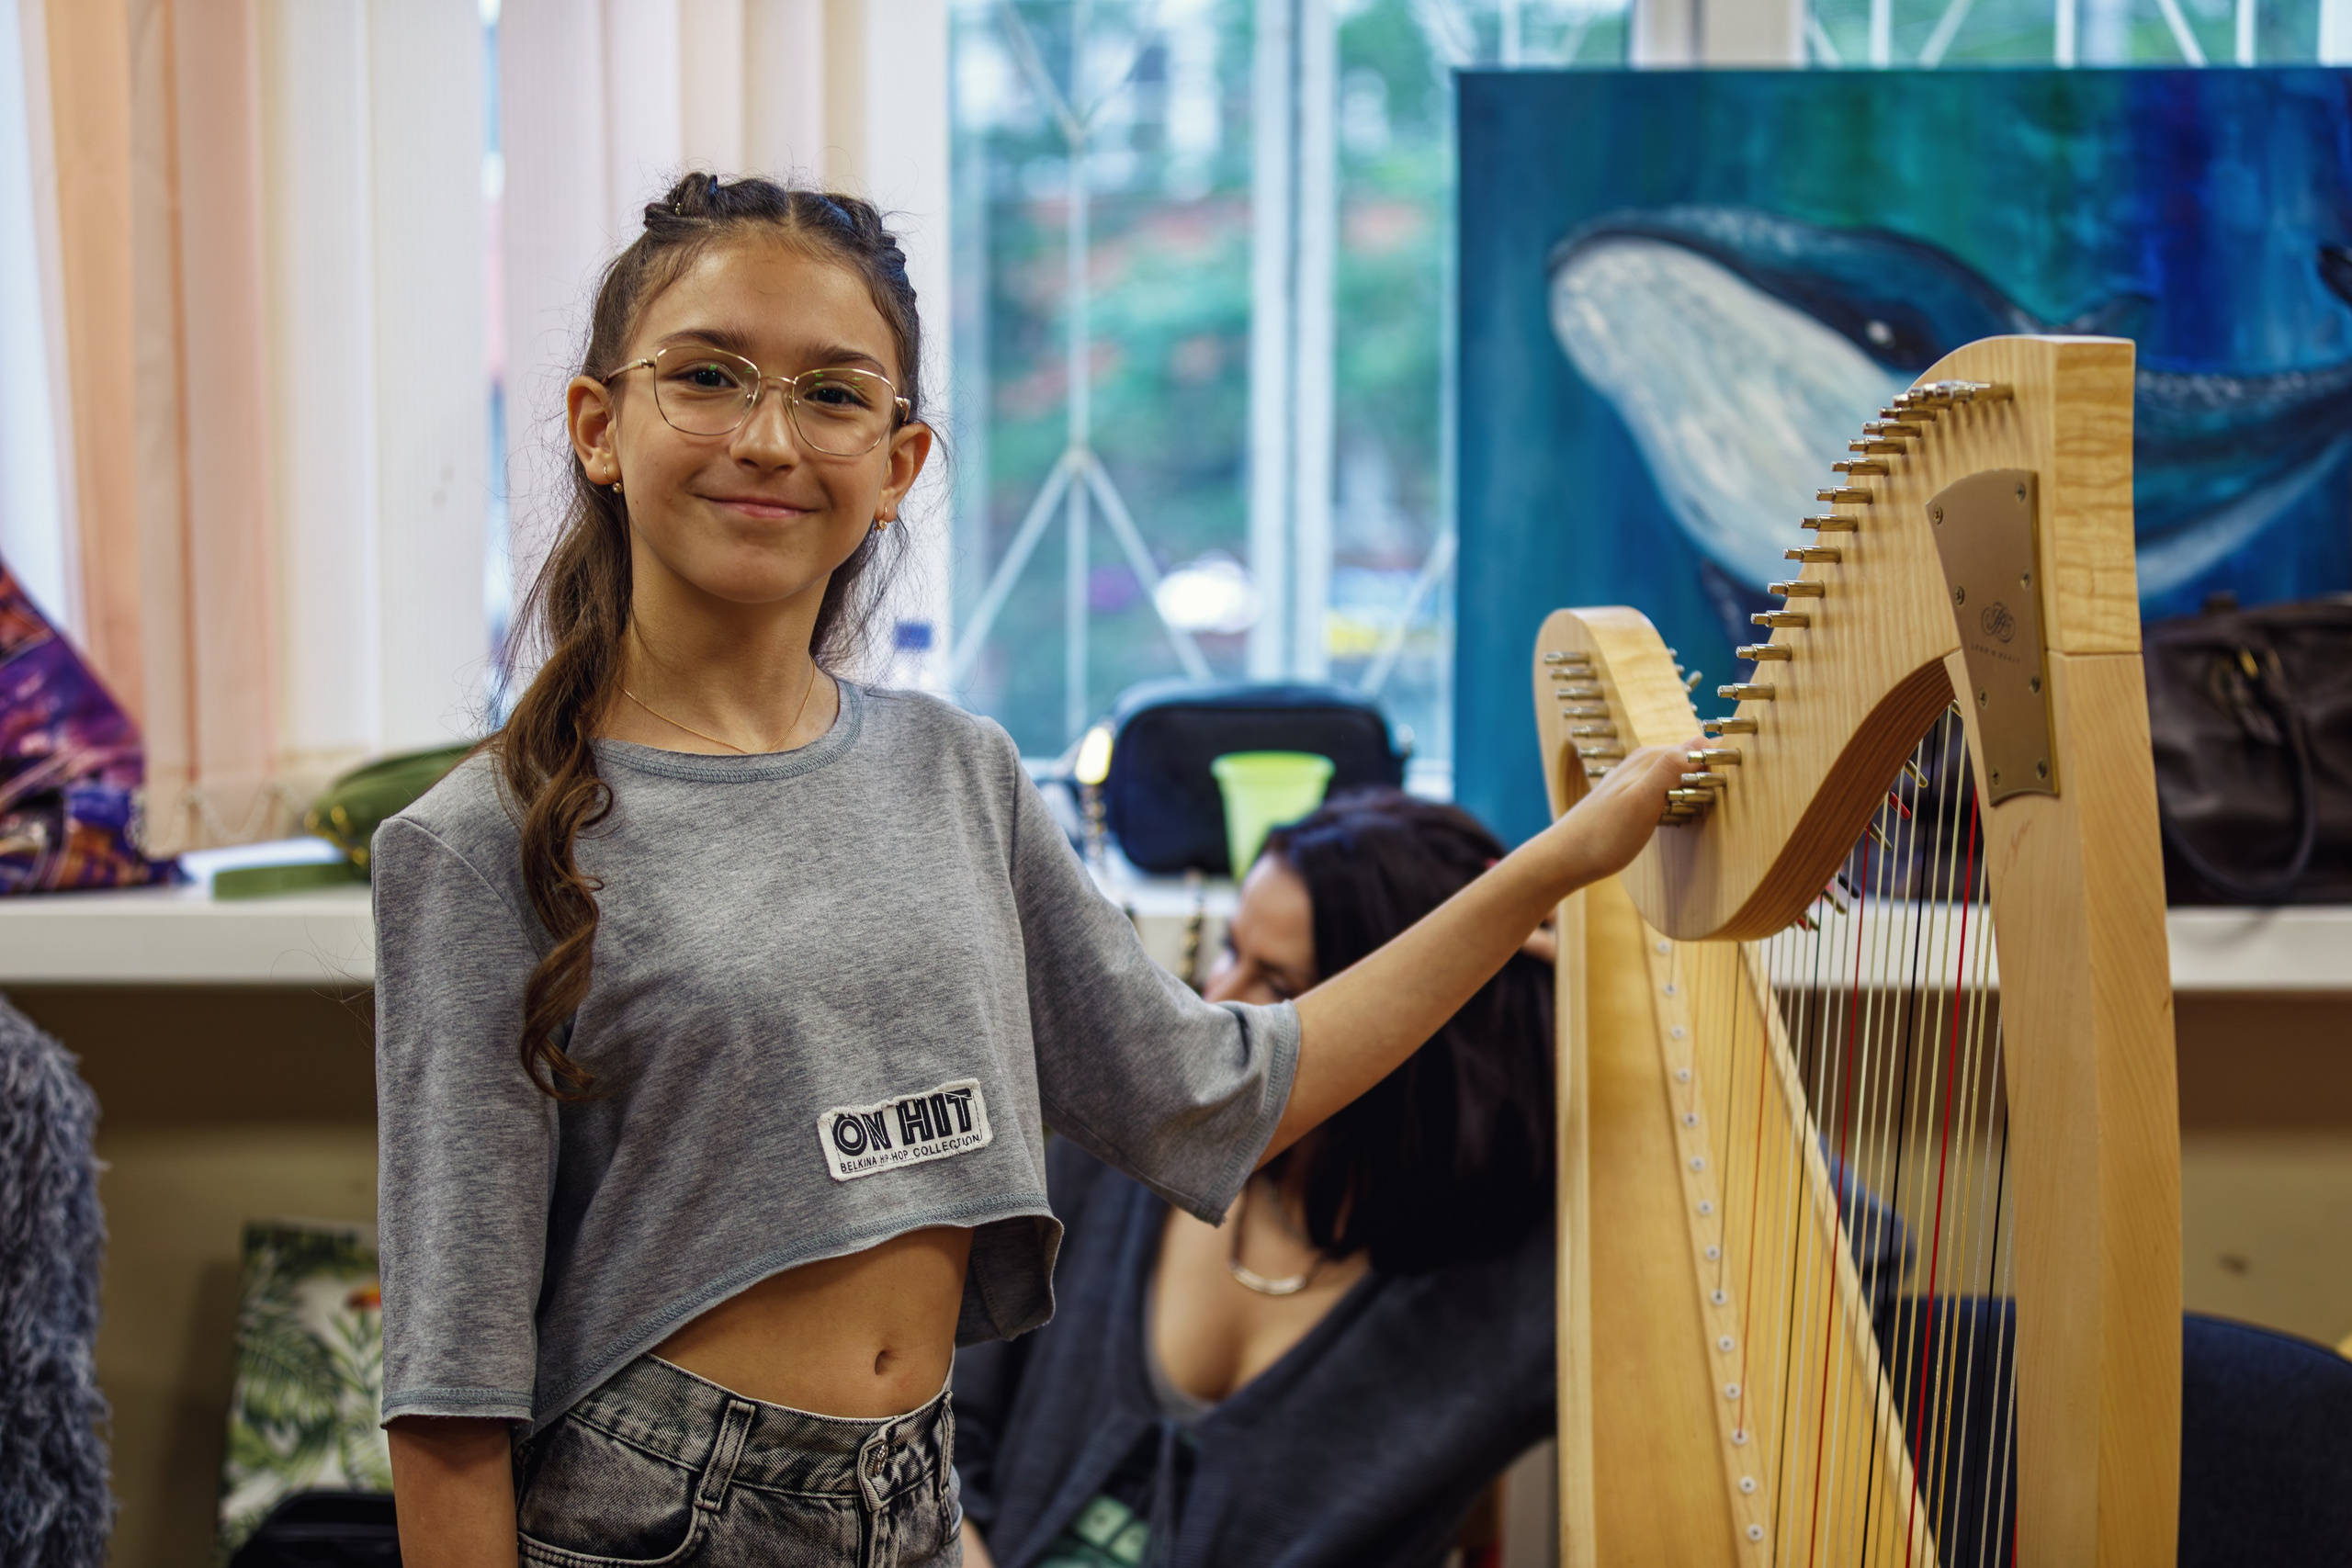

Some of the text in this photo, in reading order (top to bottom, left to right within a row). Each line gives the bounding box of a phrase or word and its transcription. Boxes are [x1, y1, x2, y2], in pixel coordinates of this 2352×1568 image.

[832, 1088, 973, 1156] ON HIT
[840, 1134, 979, 1172] BELKINA HP-HOP COLLECTION
